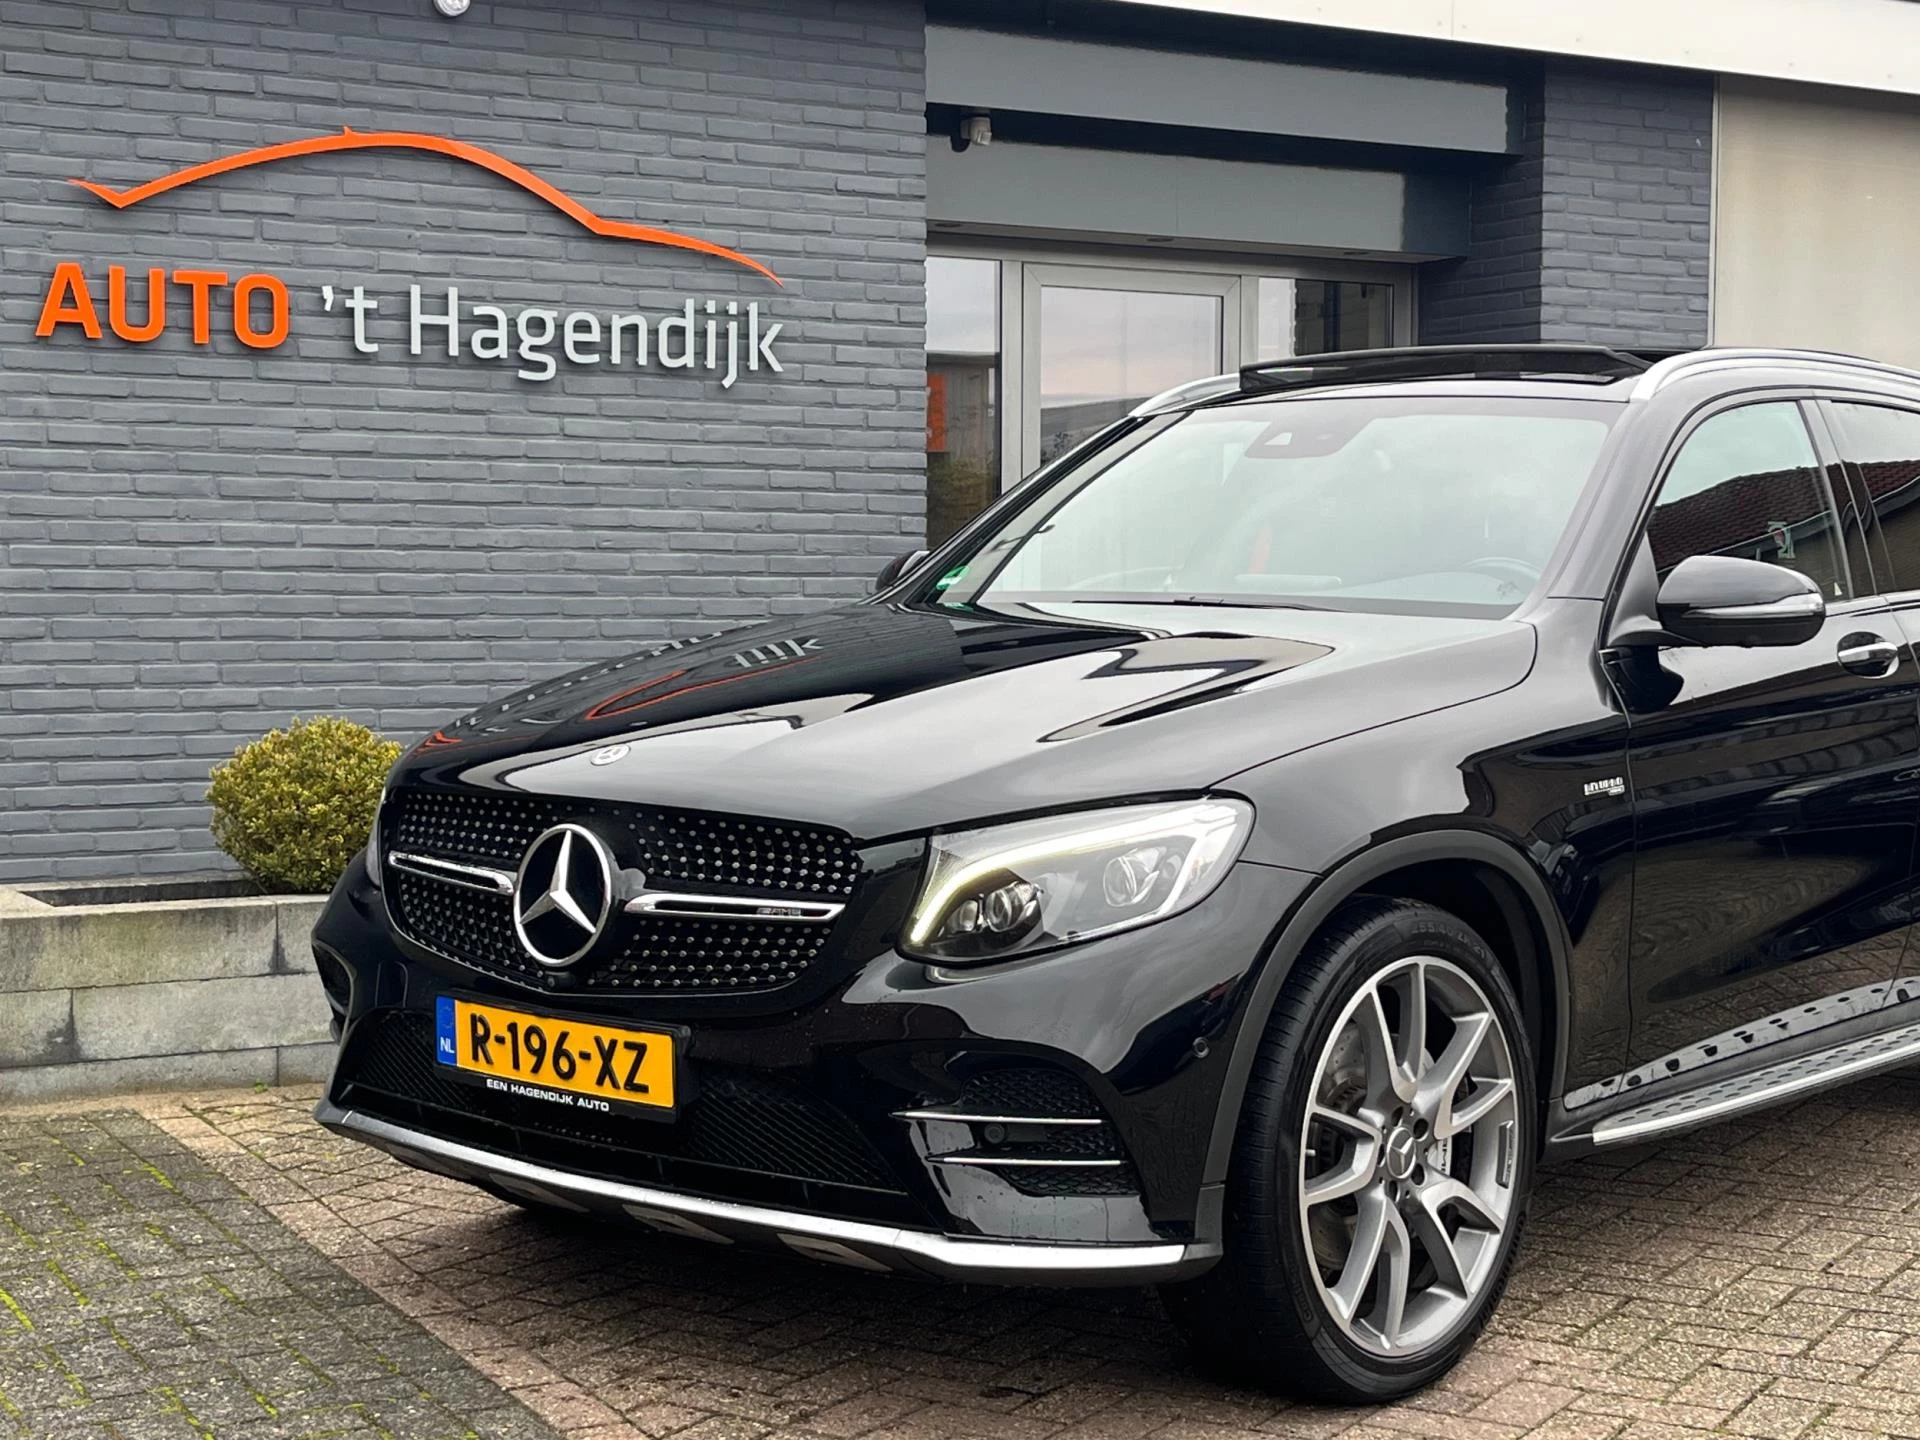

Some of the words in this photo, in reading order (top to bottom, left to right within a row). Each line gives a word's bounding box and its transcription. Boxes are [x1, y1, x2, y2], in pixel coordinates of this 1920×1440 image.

[35, 262, 291, 350] AUTO
[410, 284, 785, 389] Hagendijk
[440, 1036, 455, 1054] NL
[469, 1013, 650, 1094] R-196-XZ
[486, 1078, 508, 1092] EEN
[510, 1083, 574, 1106] HAGENDIJK
[577, 1097, 610, 1112] AUTO
